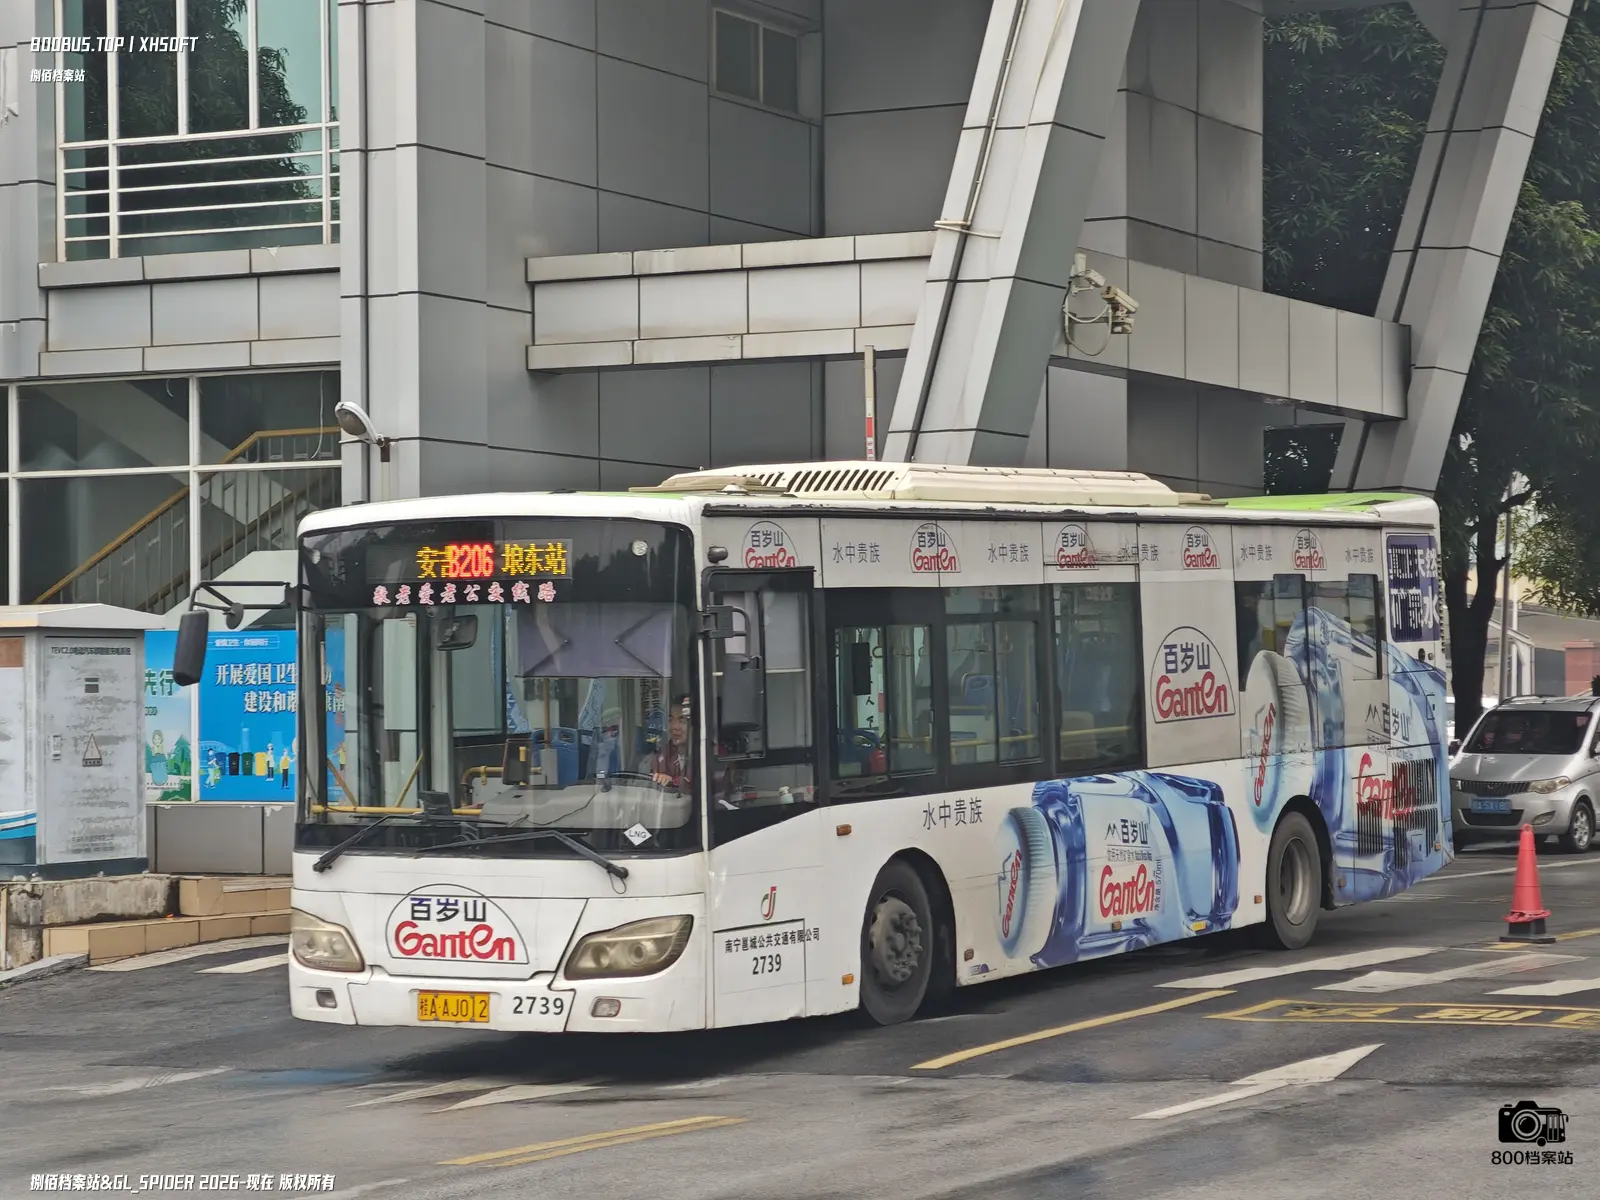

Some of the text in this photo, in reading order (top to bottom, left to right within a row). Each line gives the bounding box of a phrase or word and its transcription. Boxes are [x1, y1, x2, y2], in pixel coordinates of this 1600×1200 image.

[750, 530, 784, 548] 百岁山
[917, 531, 946, 548] 百岁山
[1061, 532, 1087, 548] 百岁山
[1186, 533, 1209, 548] 百岁山
[1297, 535, 1318, 550] 百岁山
[448, 543, 495, 578] B206
[501, 542, 567, 576] 埌东站
[832, 542, 881, 564] 水中贵族
[913, 547, 957, 571] Ganten
[987, 542, 1029, 563] 水中贵族
[1121, 543, 1160, 562] 水中贵族
[1183, 547, 1218, 568] Ganten
[1240, 544, 1273, 562] 水中贵族
[1293, 549, 1325, 569] Ganten
[1345, 547, 1375, 563] 水中贵族
[372, 580, 557, 606] 敬老爱老公交线路
[1163, 641, 1210, 675] 百岁山
[1155, 671, 1229, 719] Ganten
[922, 797, 983, 830] 水中贵族
[628, 829, 648, 839] LNG
[1120, 818, 1149, 845] 百岁山
[1099, 863, 1156, 919] Ganten
[409, 896, 488, 921] 百岁山
[394, 920, 517, 962] Ganten
[724, 927, 820, 954] 南宁邕城公共交通有限公司
[751, 953, 783, 976] 2739
[512, 995, 564, 1017] 2739
